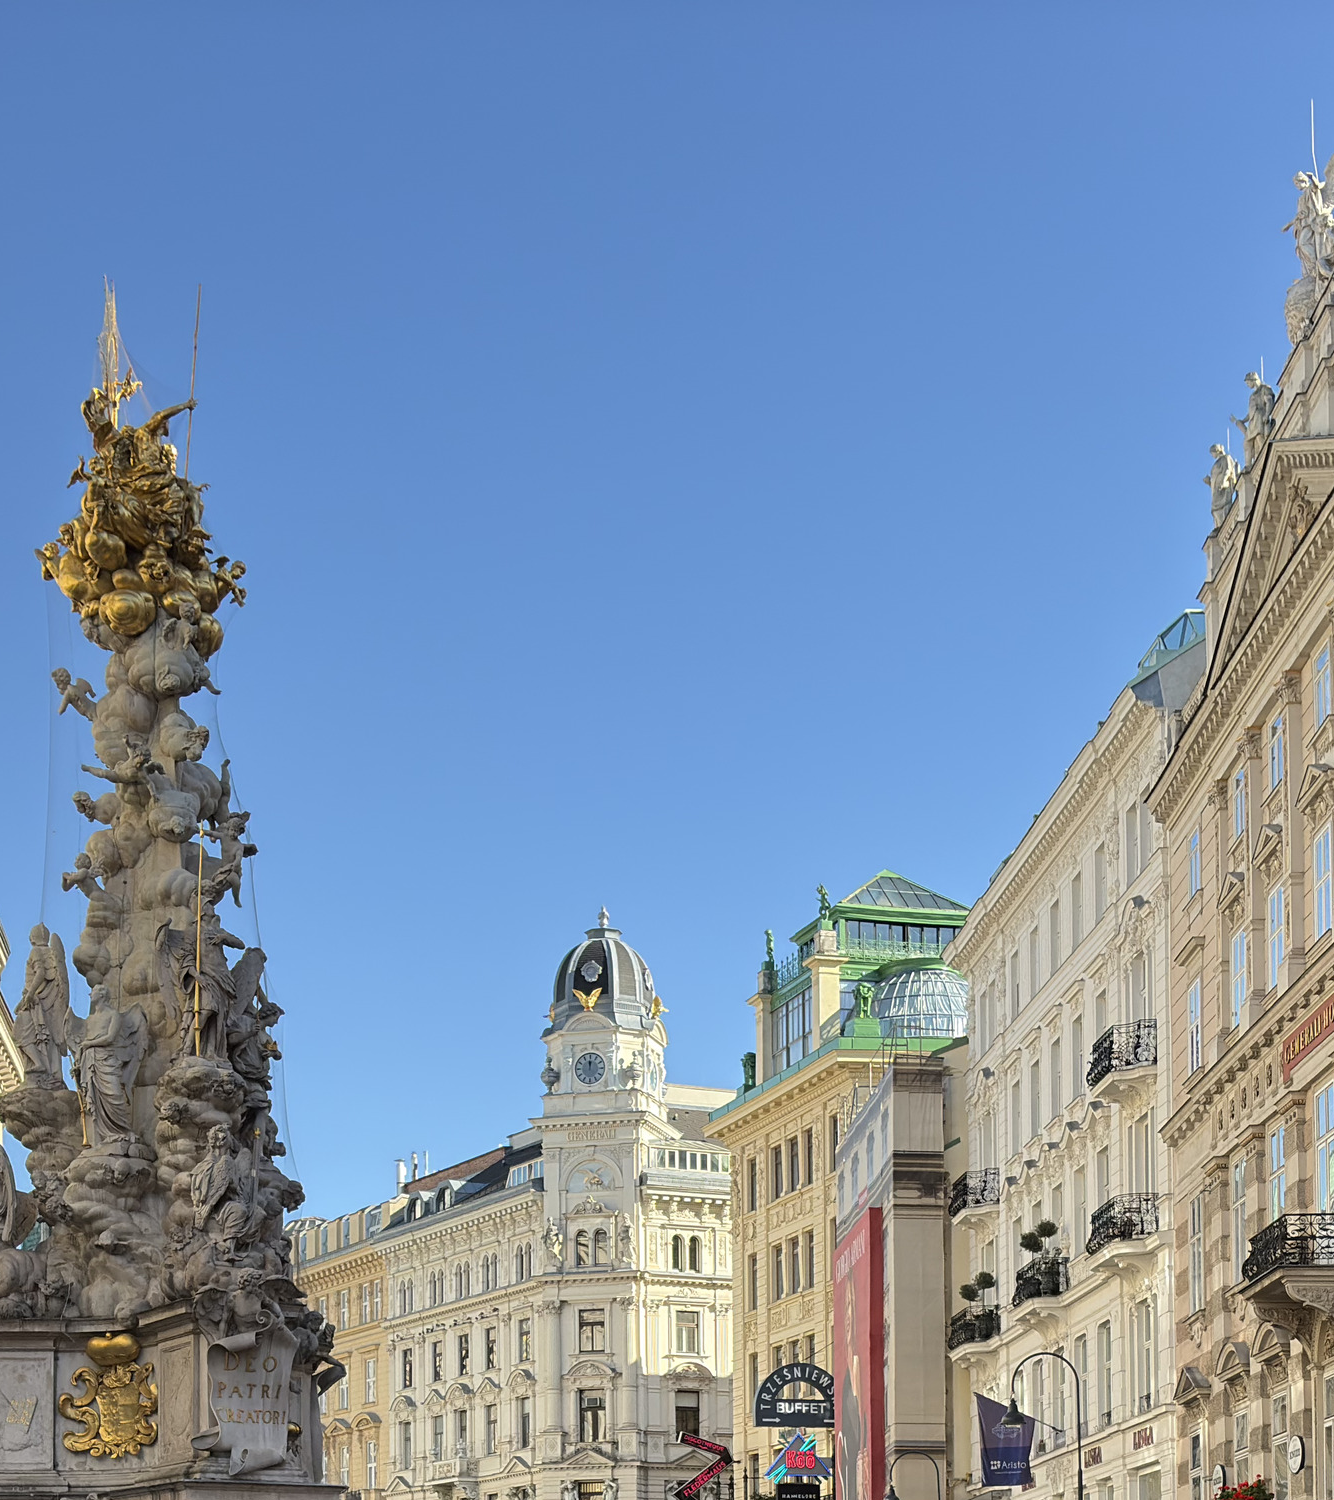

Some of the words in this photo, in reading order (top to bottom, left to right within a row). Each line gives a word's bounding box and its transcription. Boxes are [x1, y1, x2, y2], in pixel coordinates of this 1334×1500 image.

[1284, 1013, 1322, 1065] GENERALI
[567, 1129, 616, 1141] GENERALI
[224, 1351, 278, 1373] DEO
[217, 1381, 283, 1400] PATRI
[760, 1366, 835, 1411] TRZEŚNIEWS
[216, 1406, 287, 1425] CREATORI
[776, 1402, 827, 1414] BUFFET
[785, 1450, 816, 1468] Köö
[1001, 1461, 1027, 1469] Aristo
[682, 1460, 727, 1497] FLEDERMAUS
